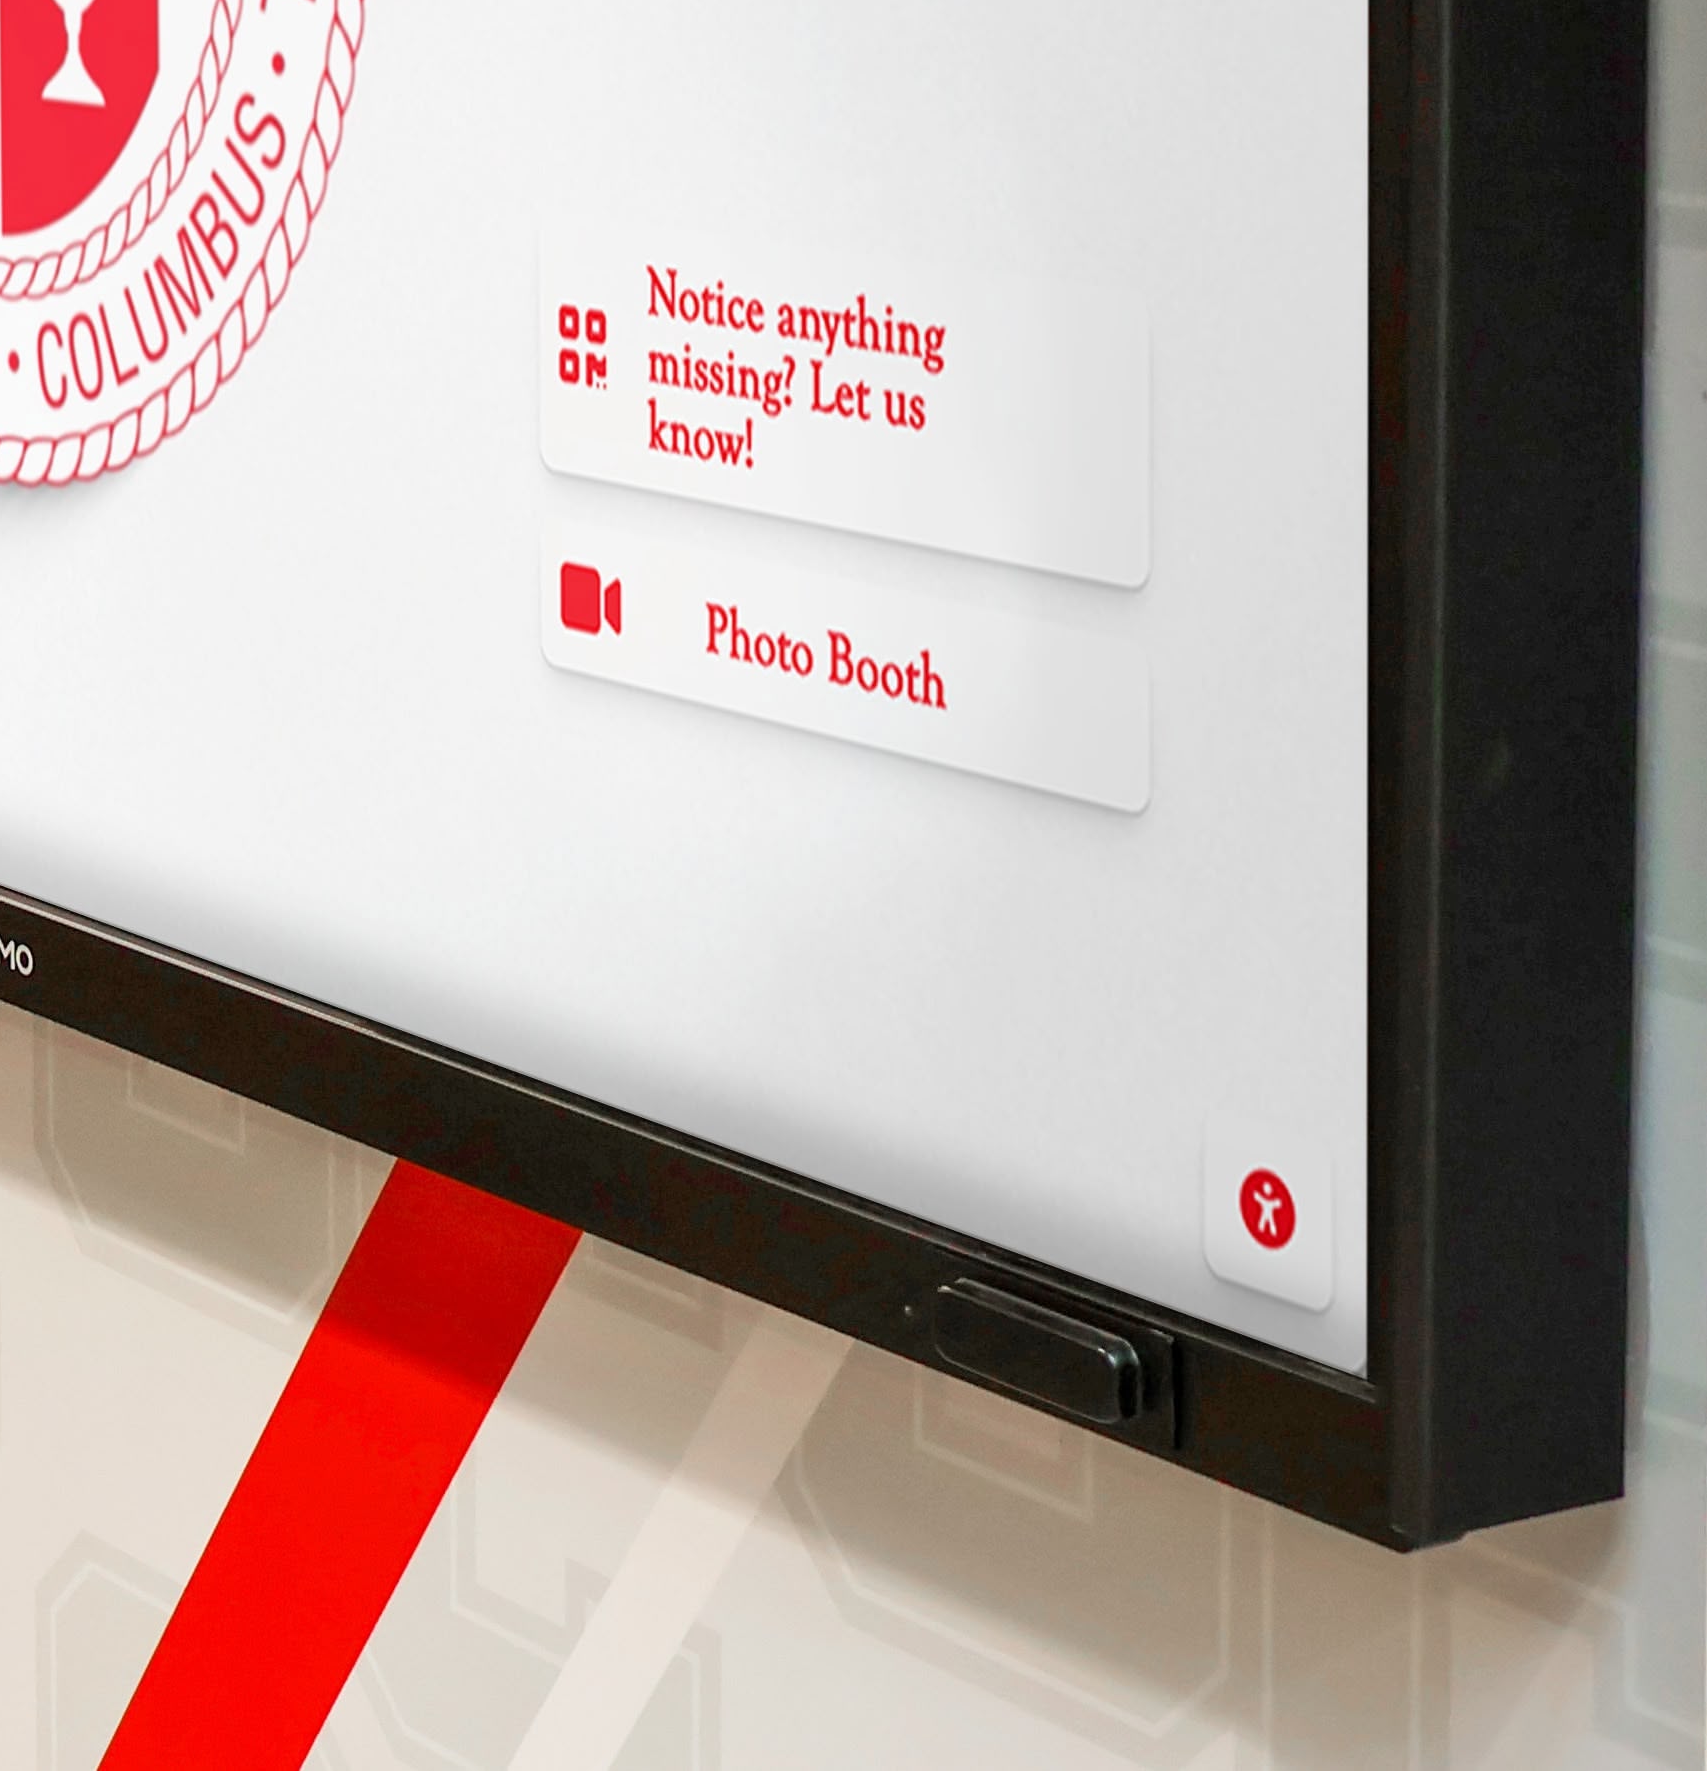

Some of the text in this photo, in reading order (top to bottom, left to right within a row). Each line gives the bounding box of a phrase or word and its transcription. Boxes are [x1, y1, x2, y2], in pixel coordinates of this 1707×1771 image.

[37, 92, 287, 410] COLUMBUS
[646, 265, 947, 375] Notice anything
[647, 343, 927, 431] missing? Let us
[647, 398, 755, 469] know!
[705, 601, 948, 711] Photo Booth
